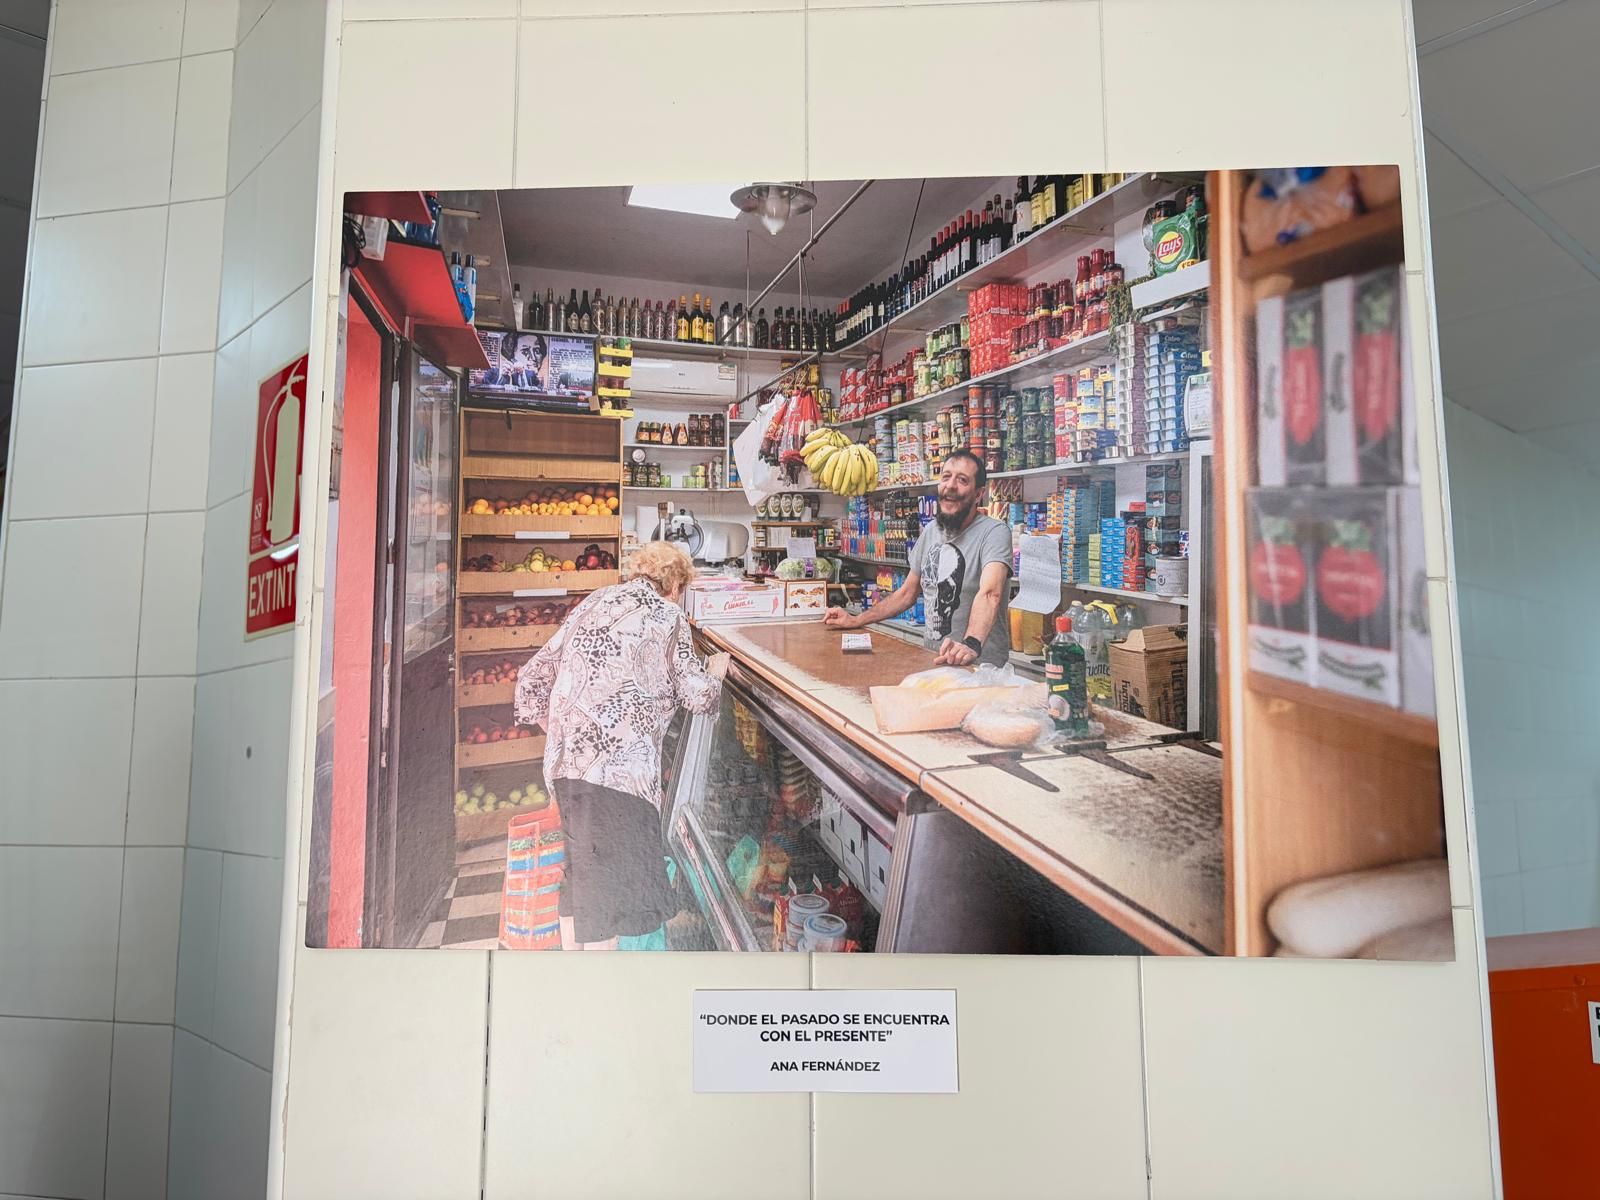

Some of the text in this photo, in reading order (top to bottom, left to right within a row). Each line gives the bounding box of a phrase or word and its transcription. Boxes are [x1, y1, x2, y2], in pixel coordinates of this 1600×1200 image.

[248, 562, 297, 618] EXTINT
[699, 1013, 950, 1026] “DONDE EL PASADO SE ENCUENTRA
[759, 1029, 893, 1043] CON EL PRESENTE”
[769, 1058, 881, 1072] ANA FERNÁNDEZ
